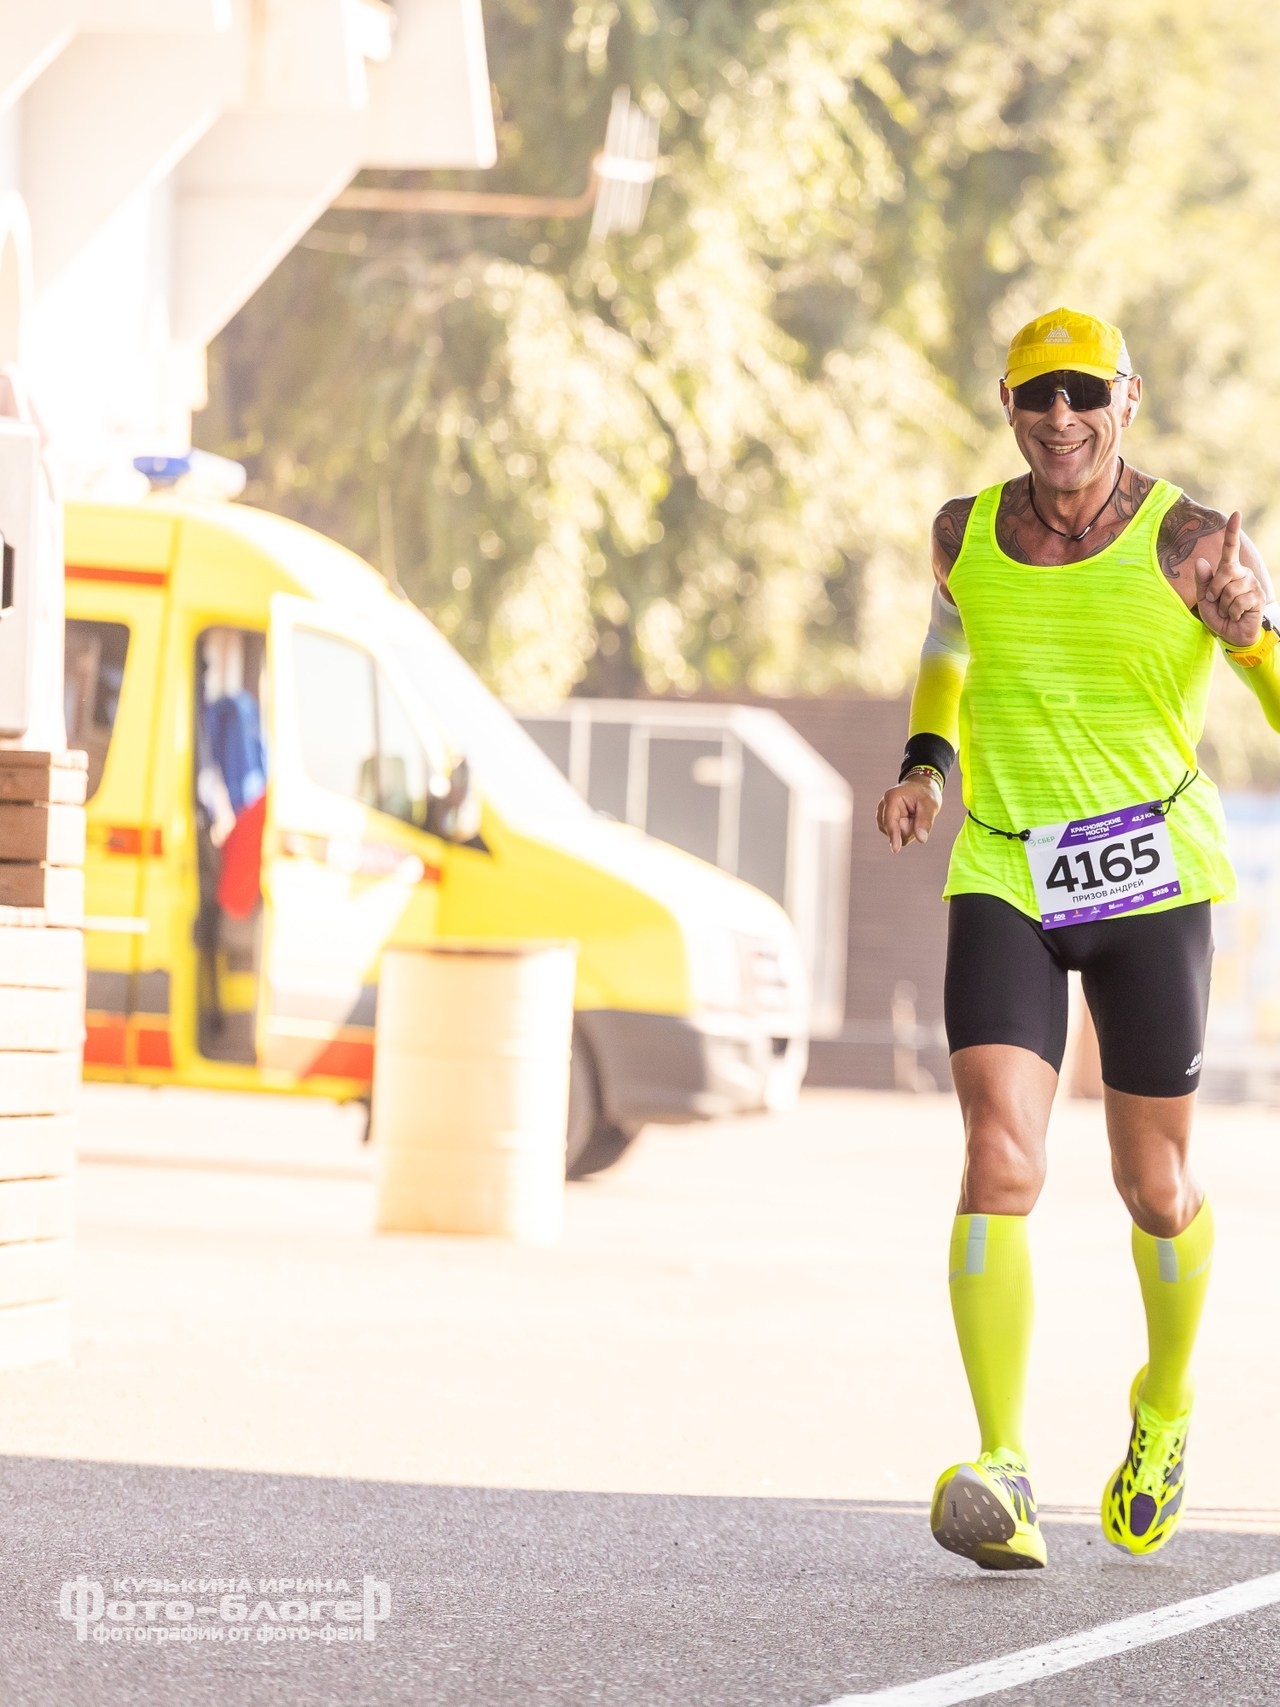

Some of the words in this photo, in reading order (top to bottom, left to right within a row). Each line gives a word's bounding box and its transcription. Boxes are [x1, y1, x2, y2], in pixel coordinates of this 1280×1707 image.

[1070, 816, 1122, 834] КРАСНОЯРСКИЕ
[1085, 826, 1110, 837] МОСТЫ
[1037, 836, 1055, 845] СБЕР
[1045, 832, 1161, 893] 4165
[1072, 890, 1108, 904] ПРИЗОВ
[1109, 879, 1144, 896] АНДРЕЙ
